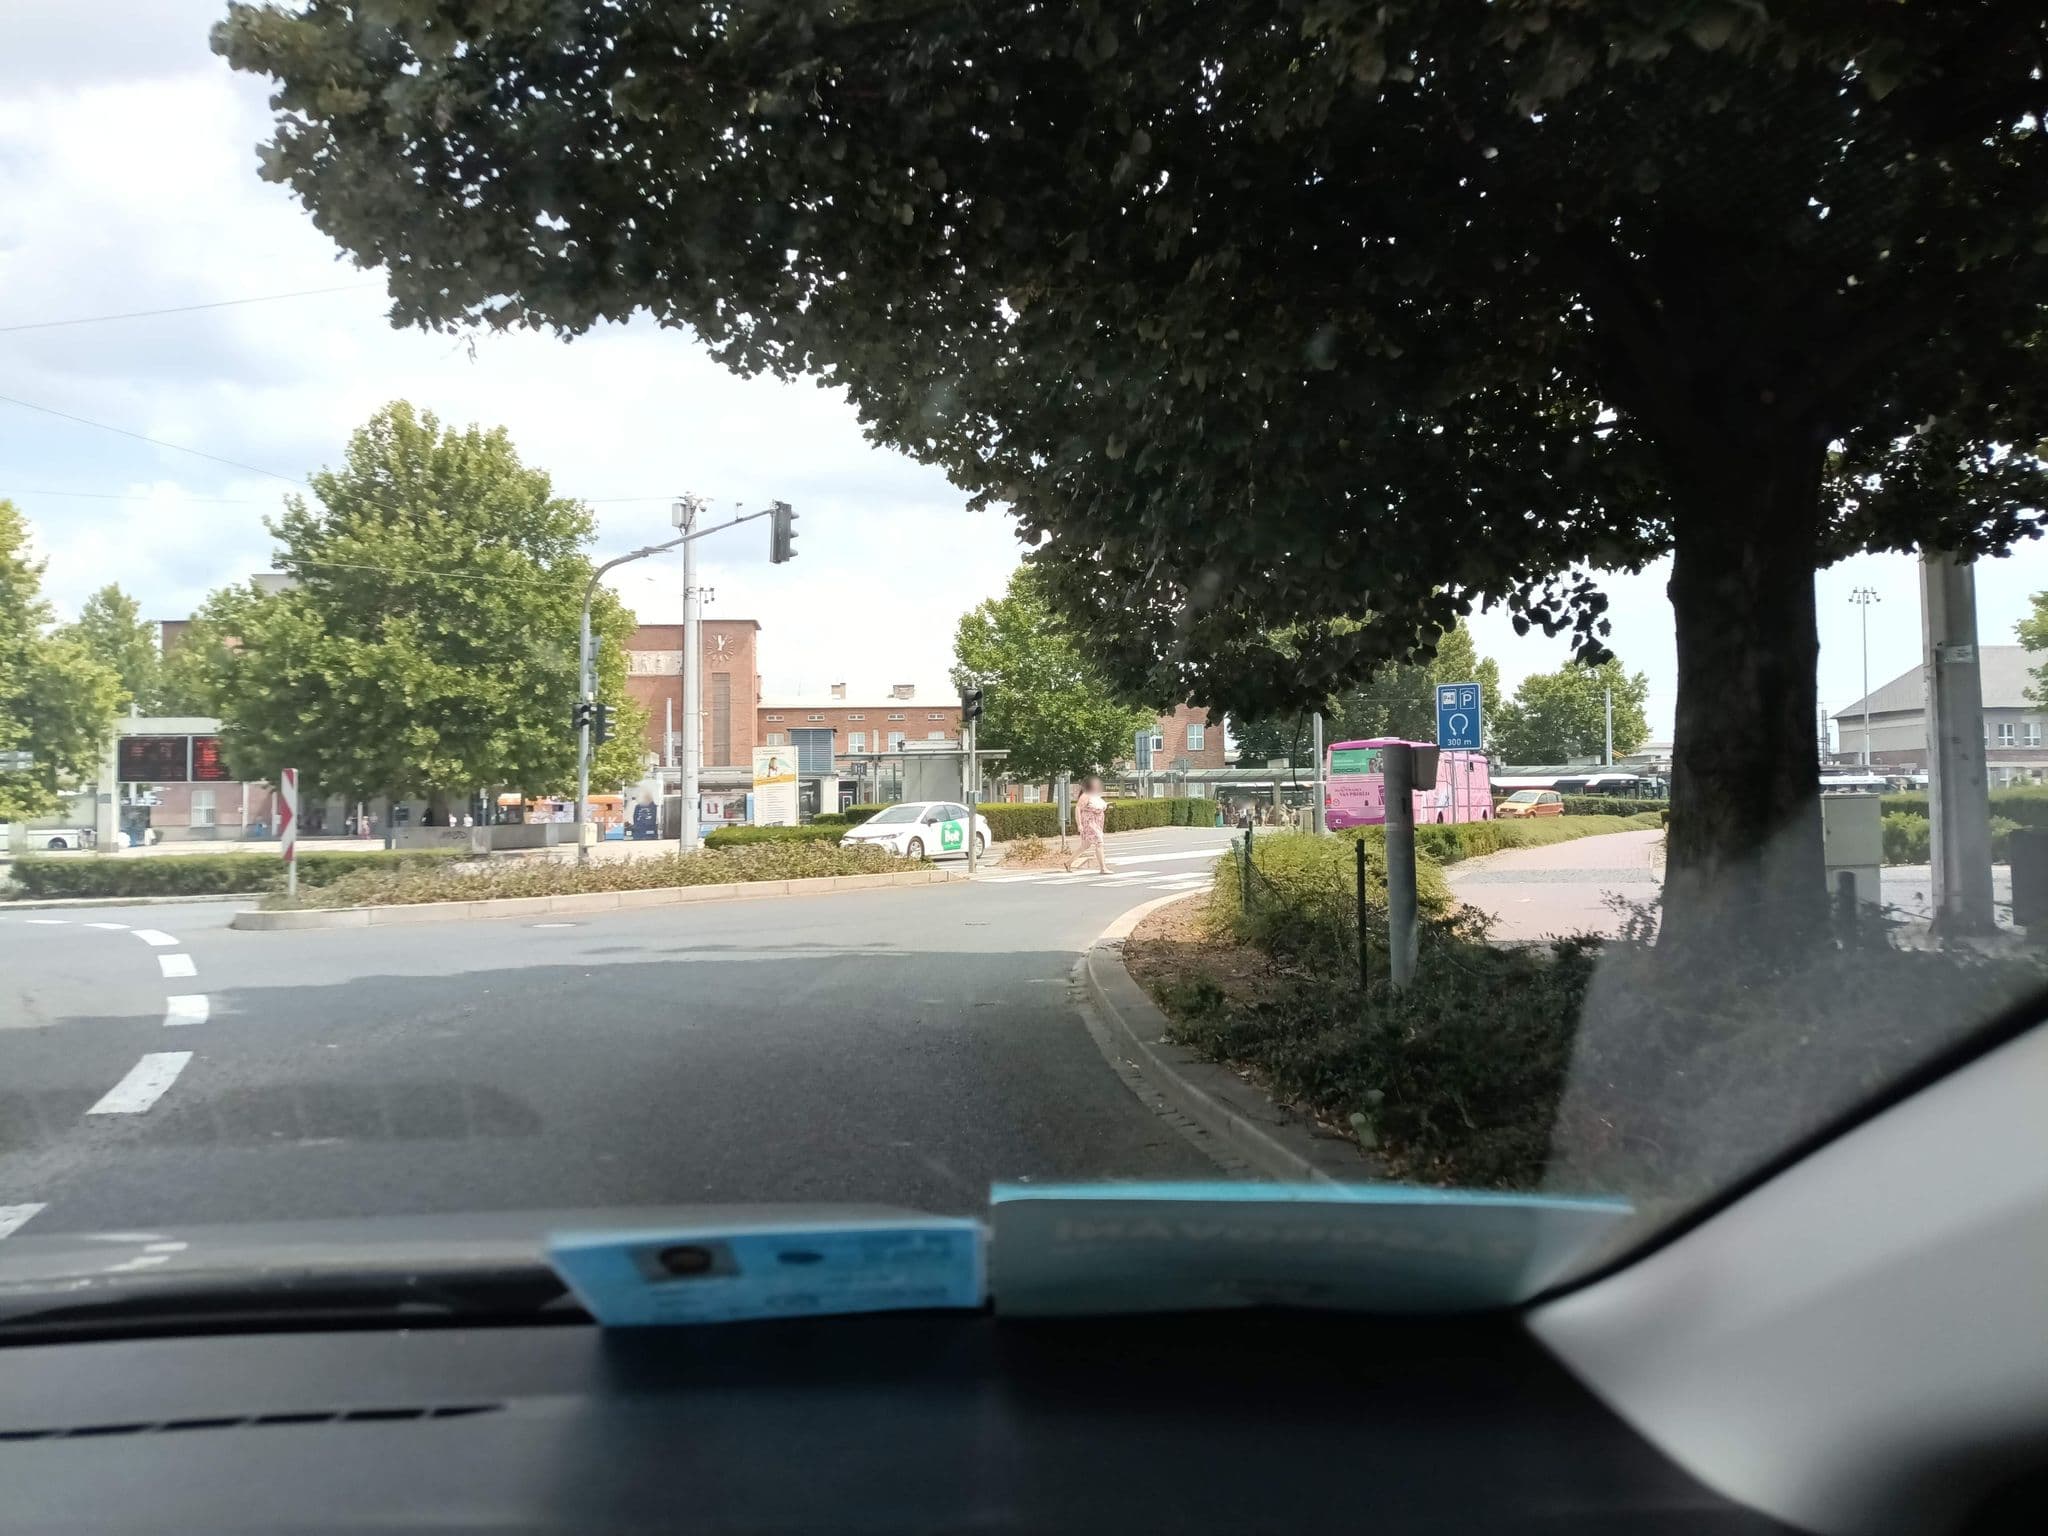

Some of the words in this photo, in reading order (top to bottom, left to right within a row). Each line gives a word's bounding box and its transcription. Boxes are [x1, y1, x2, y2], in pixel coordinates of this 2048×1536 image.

[1463, 694, 1472, 706] P
[1447, 738, 1462, 746] 300
[944, 829, 960, 843] Bolt
